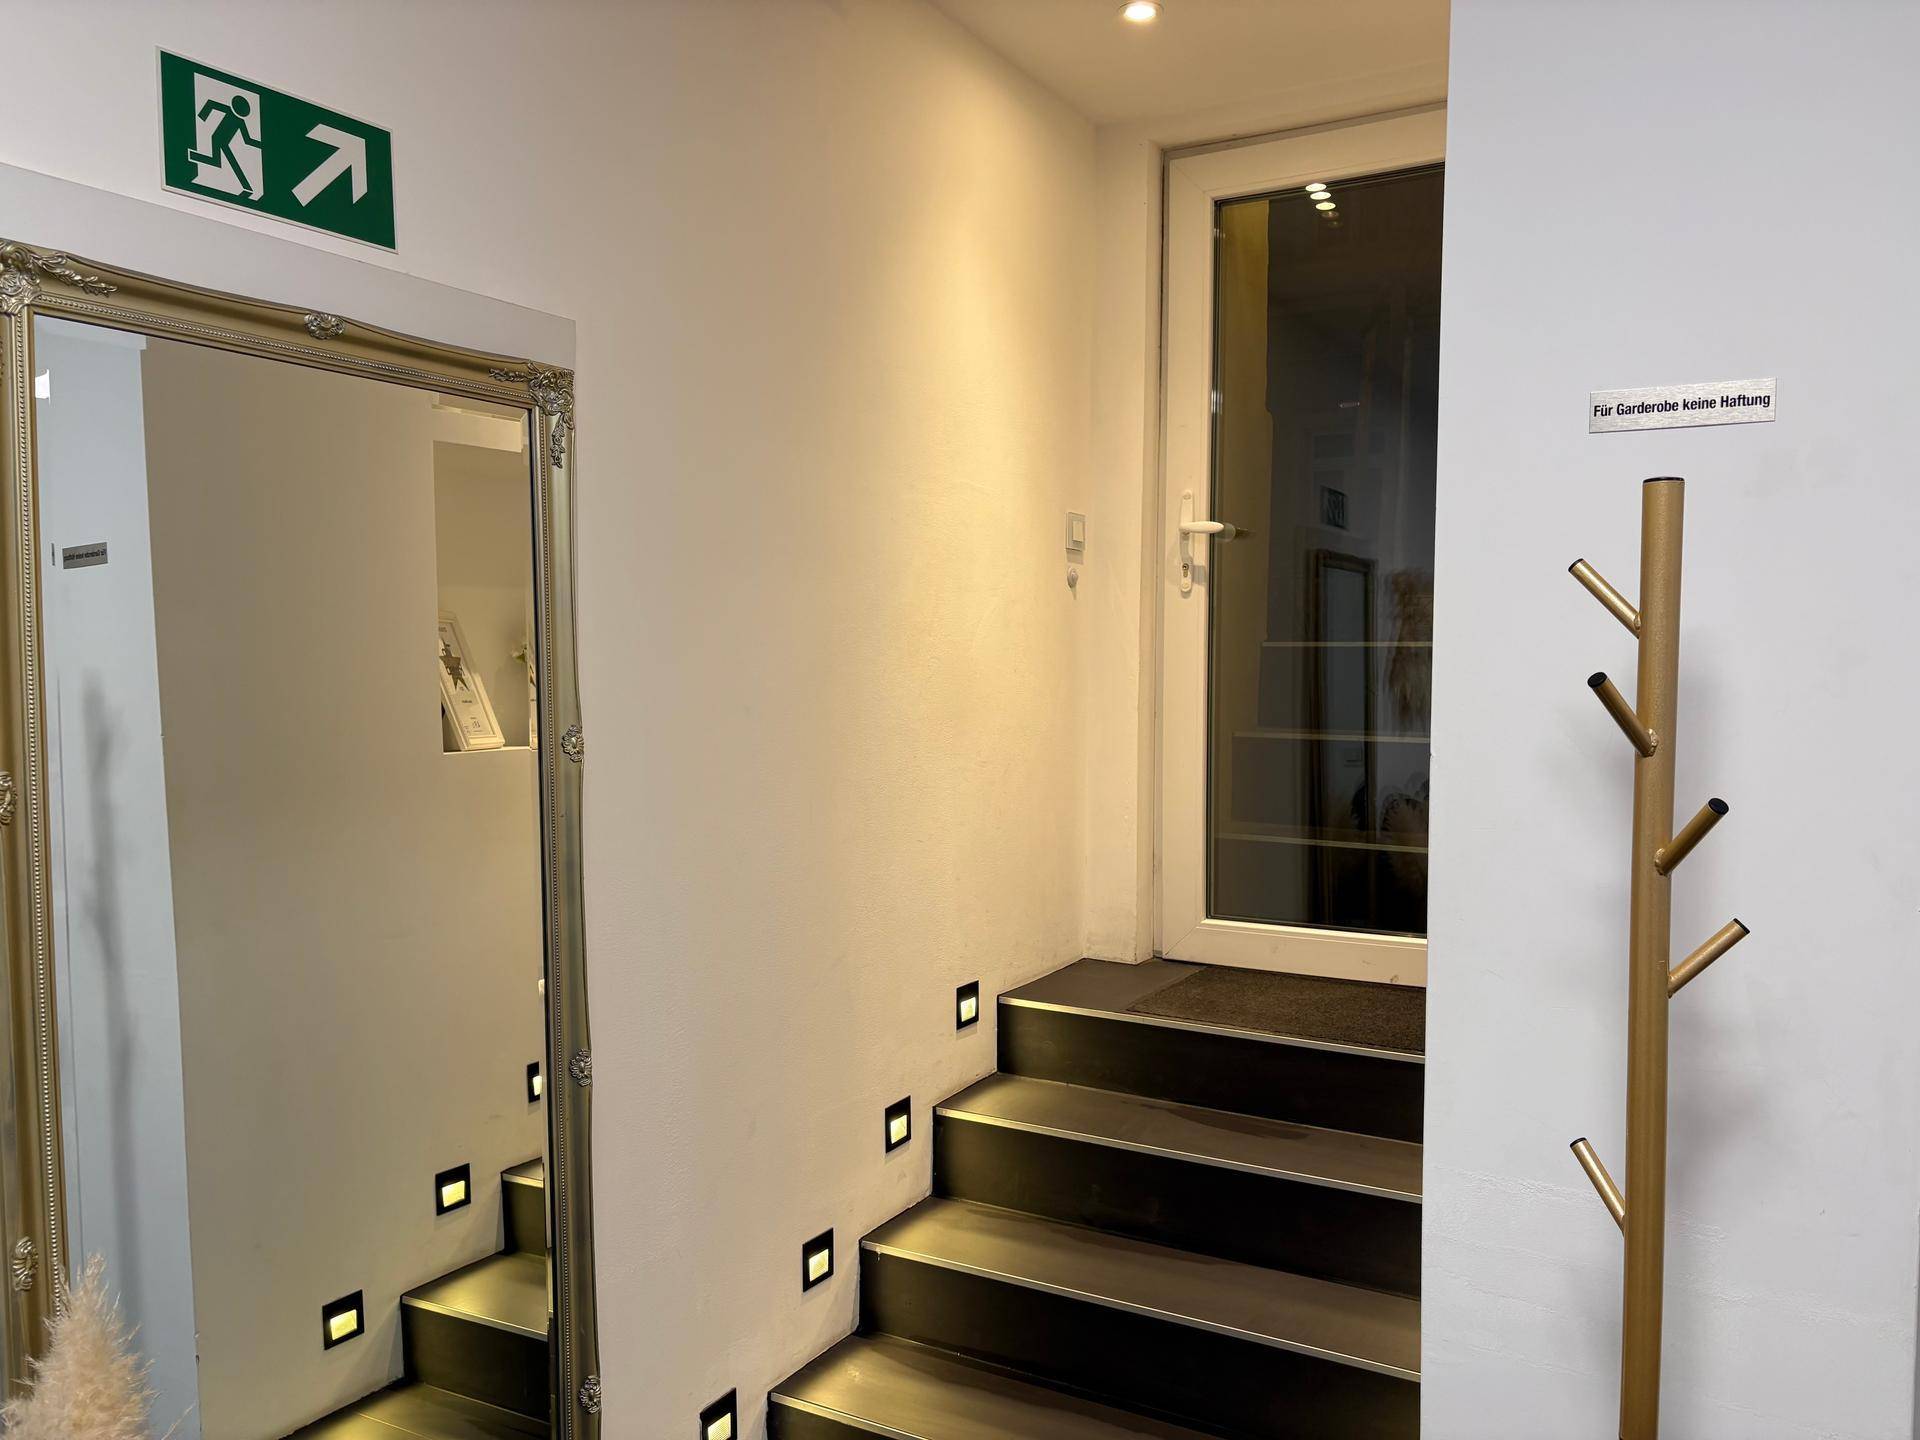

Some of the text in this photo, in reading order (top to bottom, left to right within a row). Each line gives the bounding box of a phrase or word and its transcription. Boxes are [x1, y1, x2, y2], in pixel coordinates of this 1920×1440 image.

[1593, 394, 1771, 417] Für Garderobe keine Haftung
